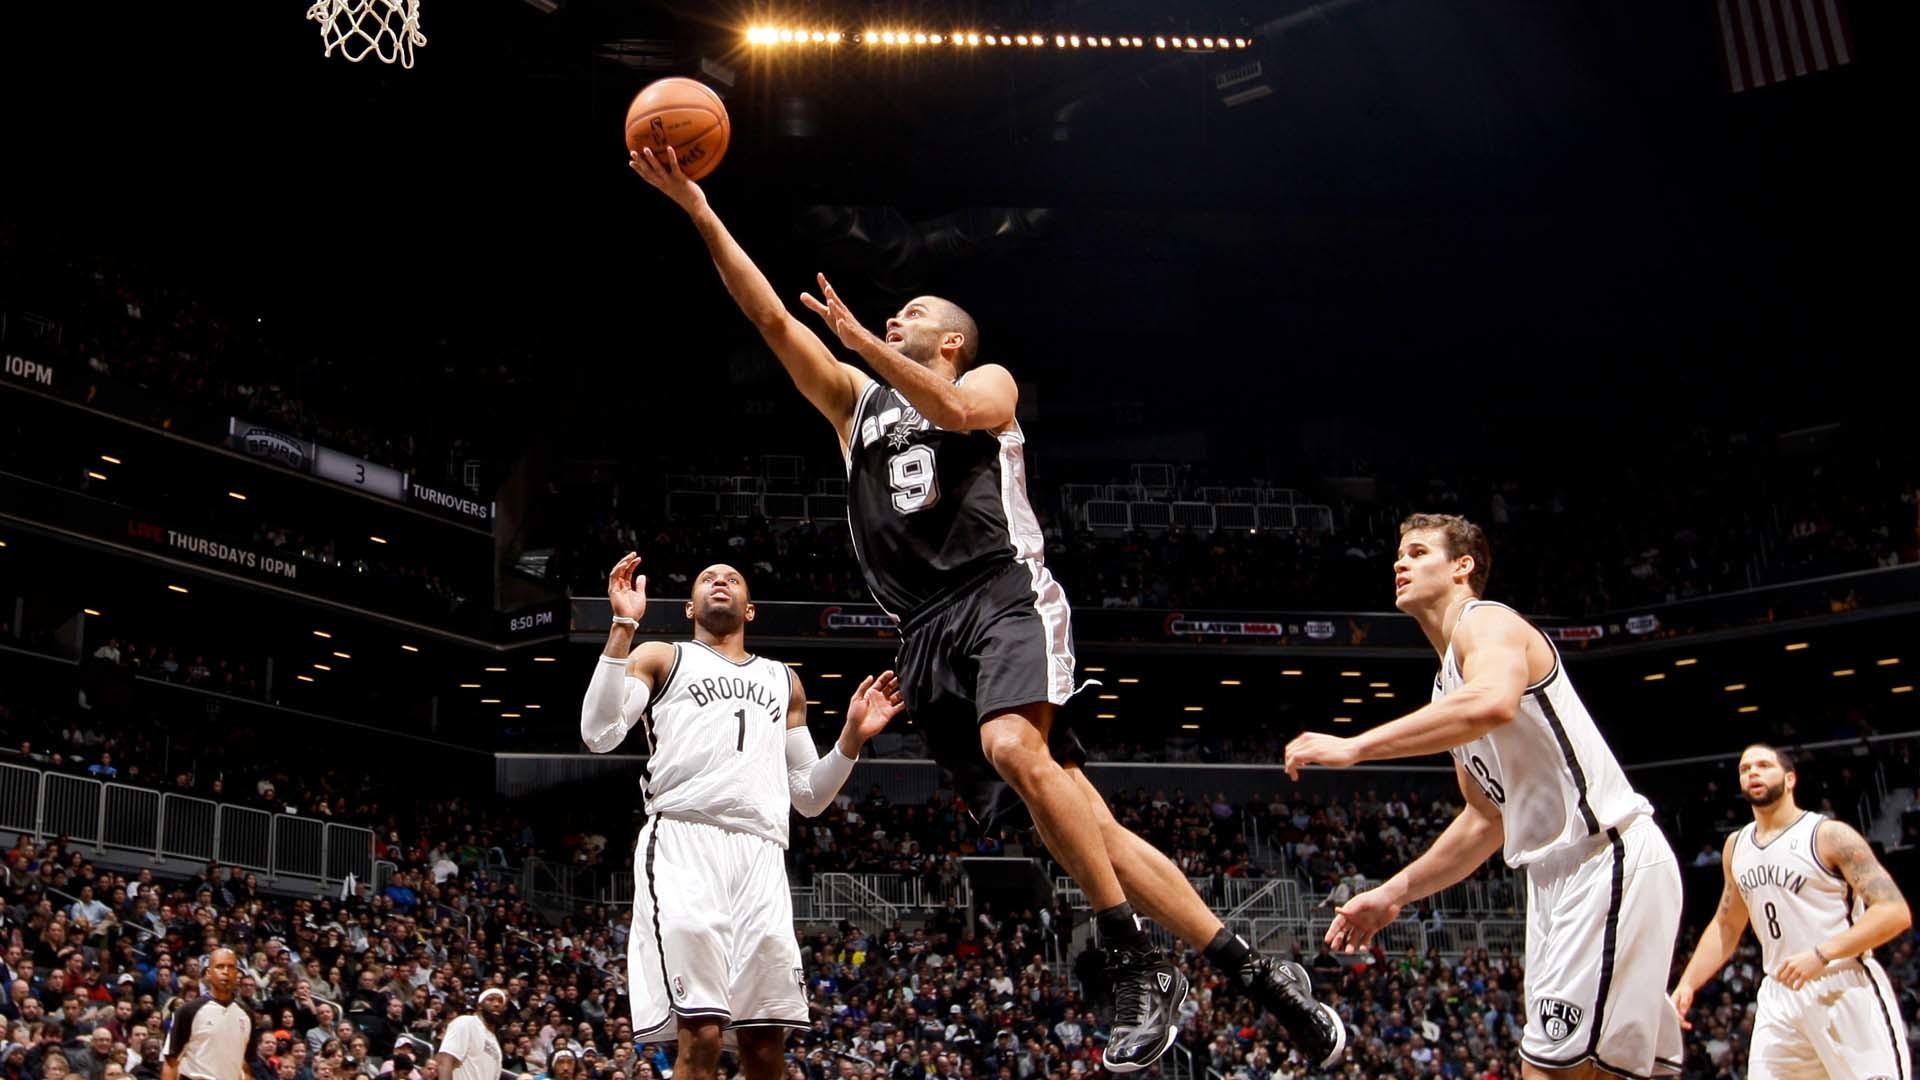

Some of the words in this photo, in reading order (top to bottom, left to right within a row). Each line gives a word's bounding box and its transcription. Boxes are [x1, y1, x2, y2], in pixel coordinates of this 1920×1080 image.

[5, 354, 54, 385] 10PM
[354, 463, 366, 485] 3
[888, 443, 941, 515] 9
[413, 483, 488, 519] TURNOVERS
[127, 519, 163, 544] LIVE
[167, 529, 257, 568] THURSDAYS
[259, 556, 297, 579] 10PM
[510, 616, 534, 631] 8:50
[535, 611, 553, 626] PM
[687, 675, 782, 723] BROOKLYN
[733, 708, 746, 753] 1
[1764, 901, 1781, 940] 8
[1541, 999, 1580, 1025] NETS
